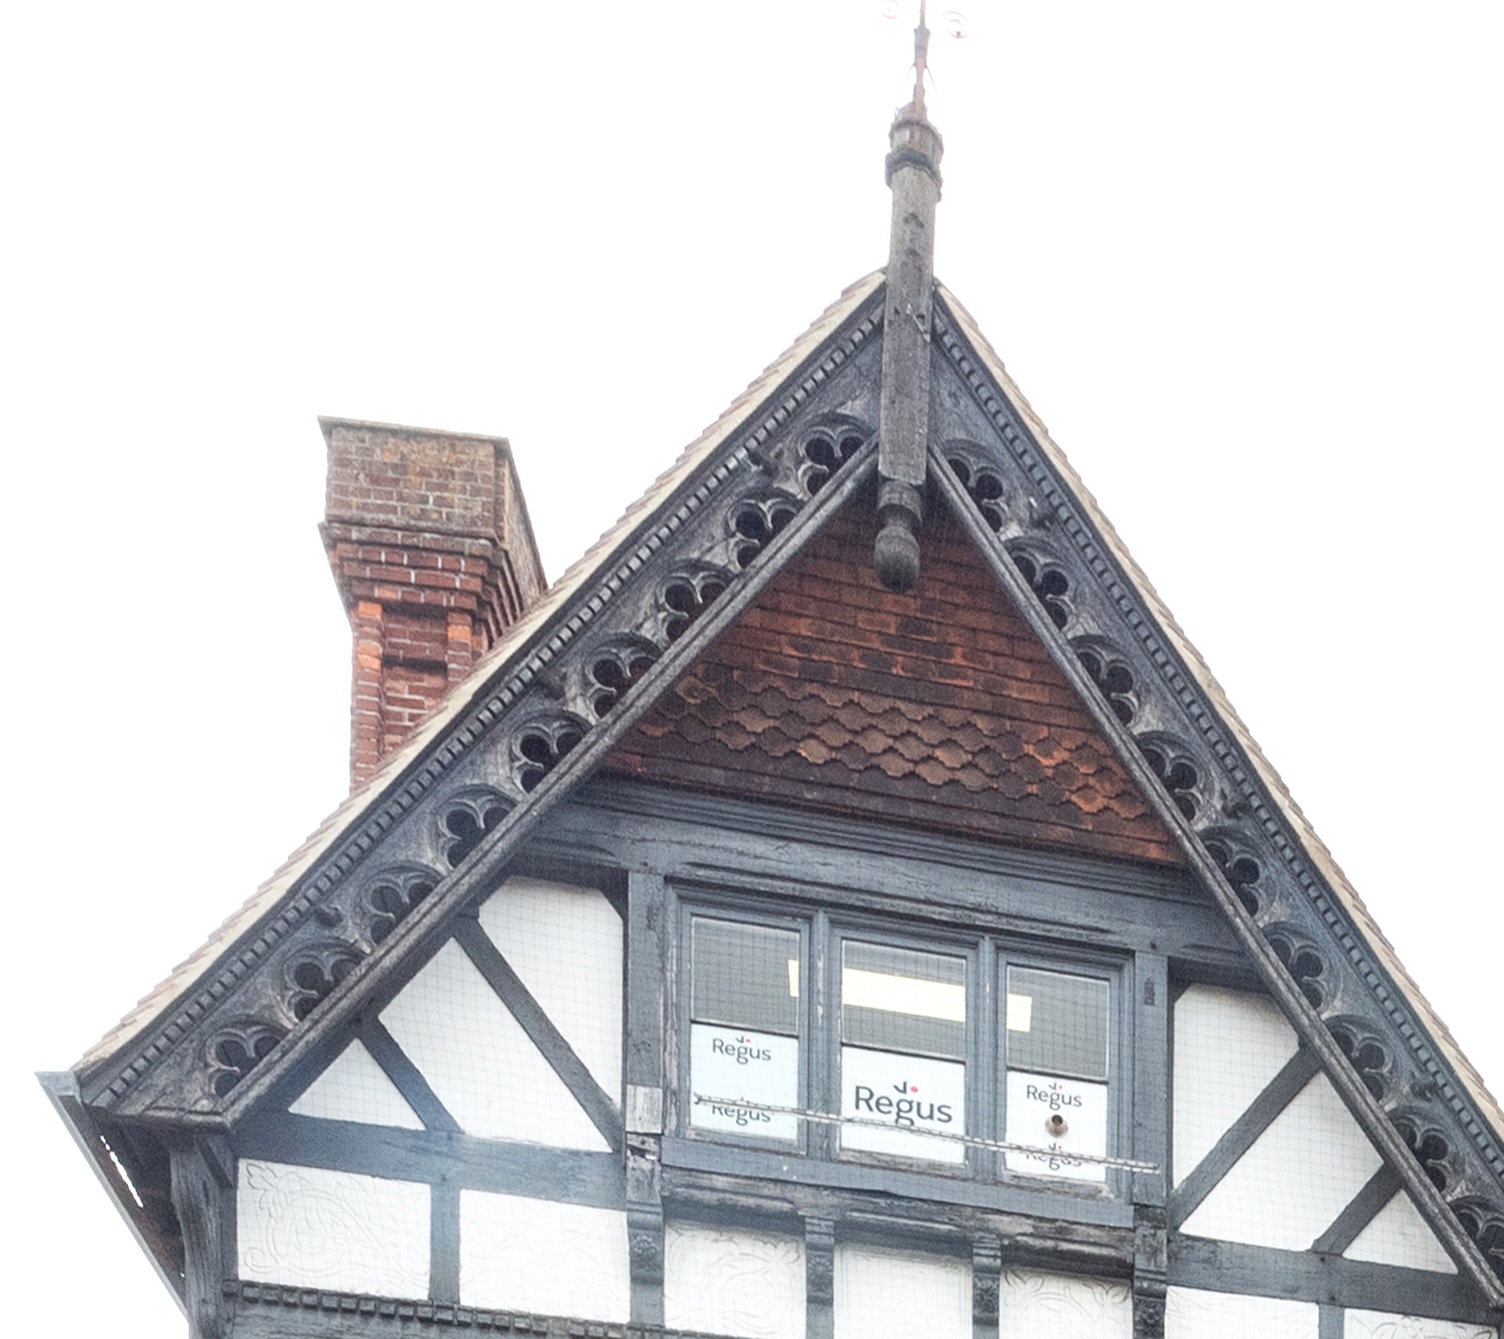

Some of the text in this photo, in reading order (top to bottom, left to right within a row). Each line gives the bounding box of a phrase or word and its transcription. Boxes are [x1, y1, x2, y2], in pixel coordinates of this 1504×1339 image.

[711, 1037, 772, 1065] Regus
[854, 1083, 953, 1127] Regus
[1026, 1084, 1083, 1110] Regus
